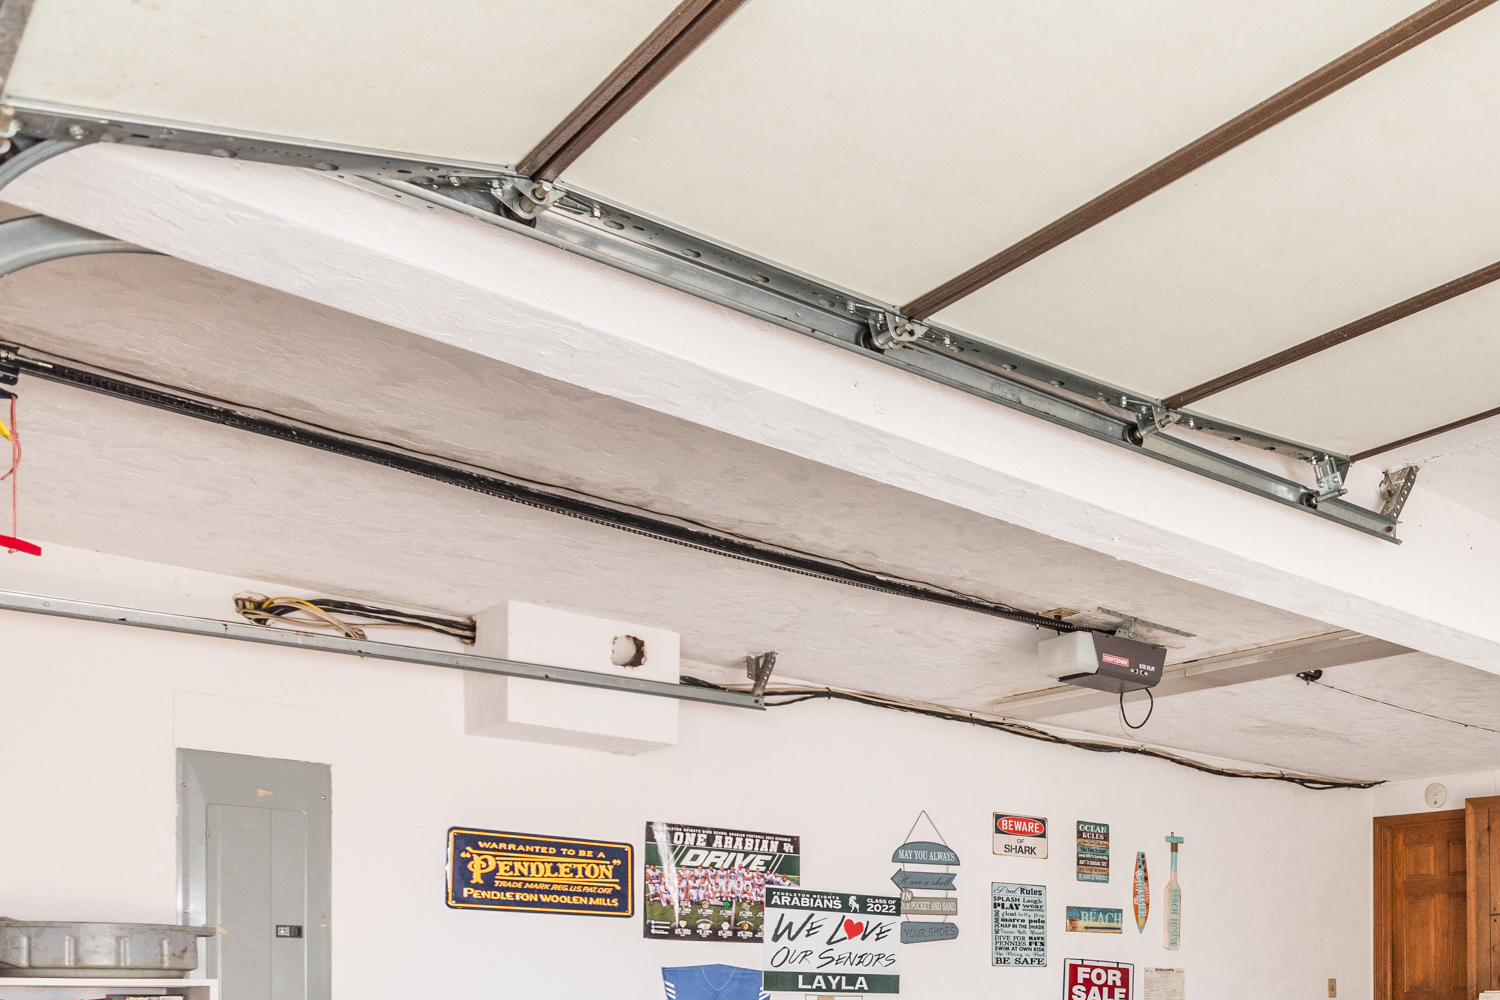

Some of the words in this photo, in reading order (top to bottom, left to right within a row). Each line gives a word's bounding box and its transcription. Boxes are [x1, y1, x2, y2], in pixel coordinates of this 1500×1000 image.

[1002, 820, 1040, 834] BEWARE
[1079, 824, 1107, 833] OCEAN
[478, 841, 556, 854] WARRANTED
[673, 832, 707, 846] ONE
[712, 835, 779, 852] ARABIAN
[898, 849, 912, 859] MAY
[914, 850, 928, 860] YOU
[929, 851, 955, 861] ALWAYS
[1004, 844, 1037, 856] SHARK
[680, 849, 773, 871] DRIVE
[463, 888, 538, 901] PENDLETON
[539, 894, 587, 905] WOOLEN
[589, 898, 618, 906] MILLS
[771, 896, 842, 909] ARABIANS
[902, 892, 912, 900] IN
[866, 904, 896, 913] 2022
[912, 902, 930, 910] POCKET
[930, 902, 941, 910] AND
[942, 902, 956, 911] SAND
[1081, 911, 1122, 926] BEACH
[771, 913, 828, 943] WE
[904, 928, 926, 938] YOUR
[928, 926, 956, 937] SHOES
[1170, 918, 1178, 947] HOUSE
[771, 946, 813, 968] OUR
[816, 948, 896, 969] SENIORS
[798, 975, 868, 990] LAYLA
[1077, 967, 1122, 986] FOR
